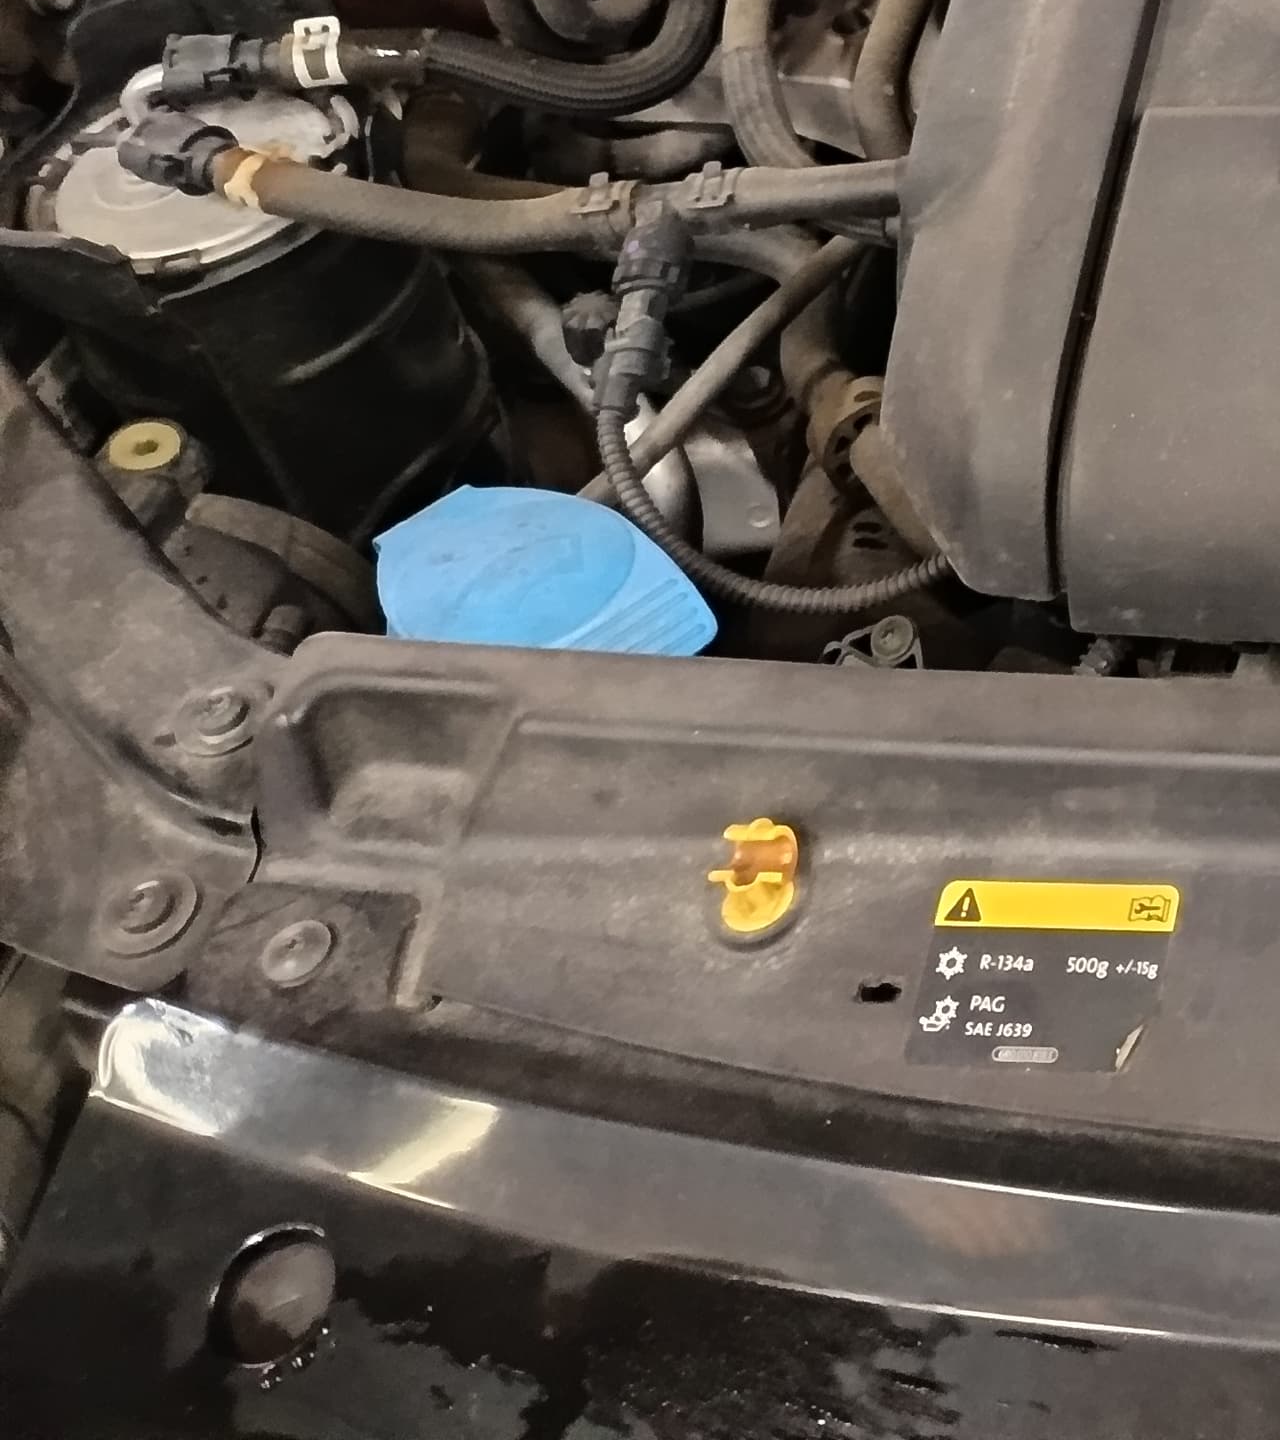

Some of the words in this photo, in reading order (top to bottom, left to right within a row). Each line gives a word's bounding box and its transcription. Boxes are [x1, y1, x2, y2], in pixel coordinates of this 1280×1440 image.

[979, 953, 1034, 972] R-134a
[1066, 956, 1109, 979] 500g
[1115, 958, 1159, 980] +/-15g
[969, 995, 1006, 1013] PAG
[964, 1021, 993, 1036] SAE
[996, 1022, 1033, 1037] J639
